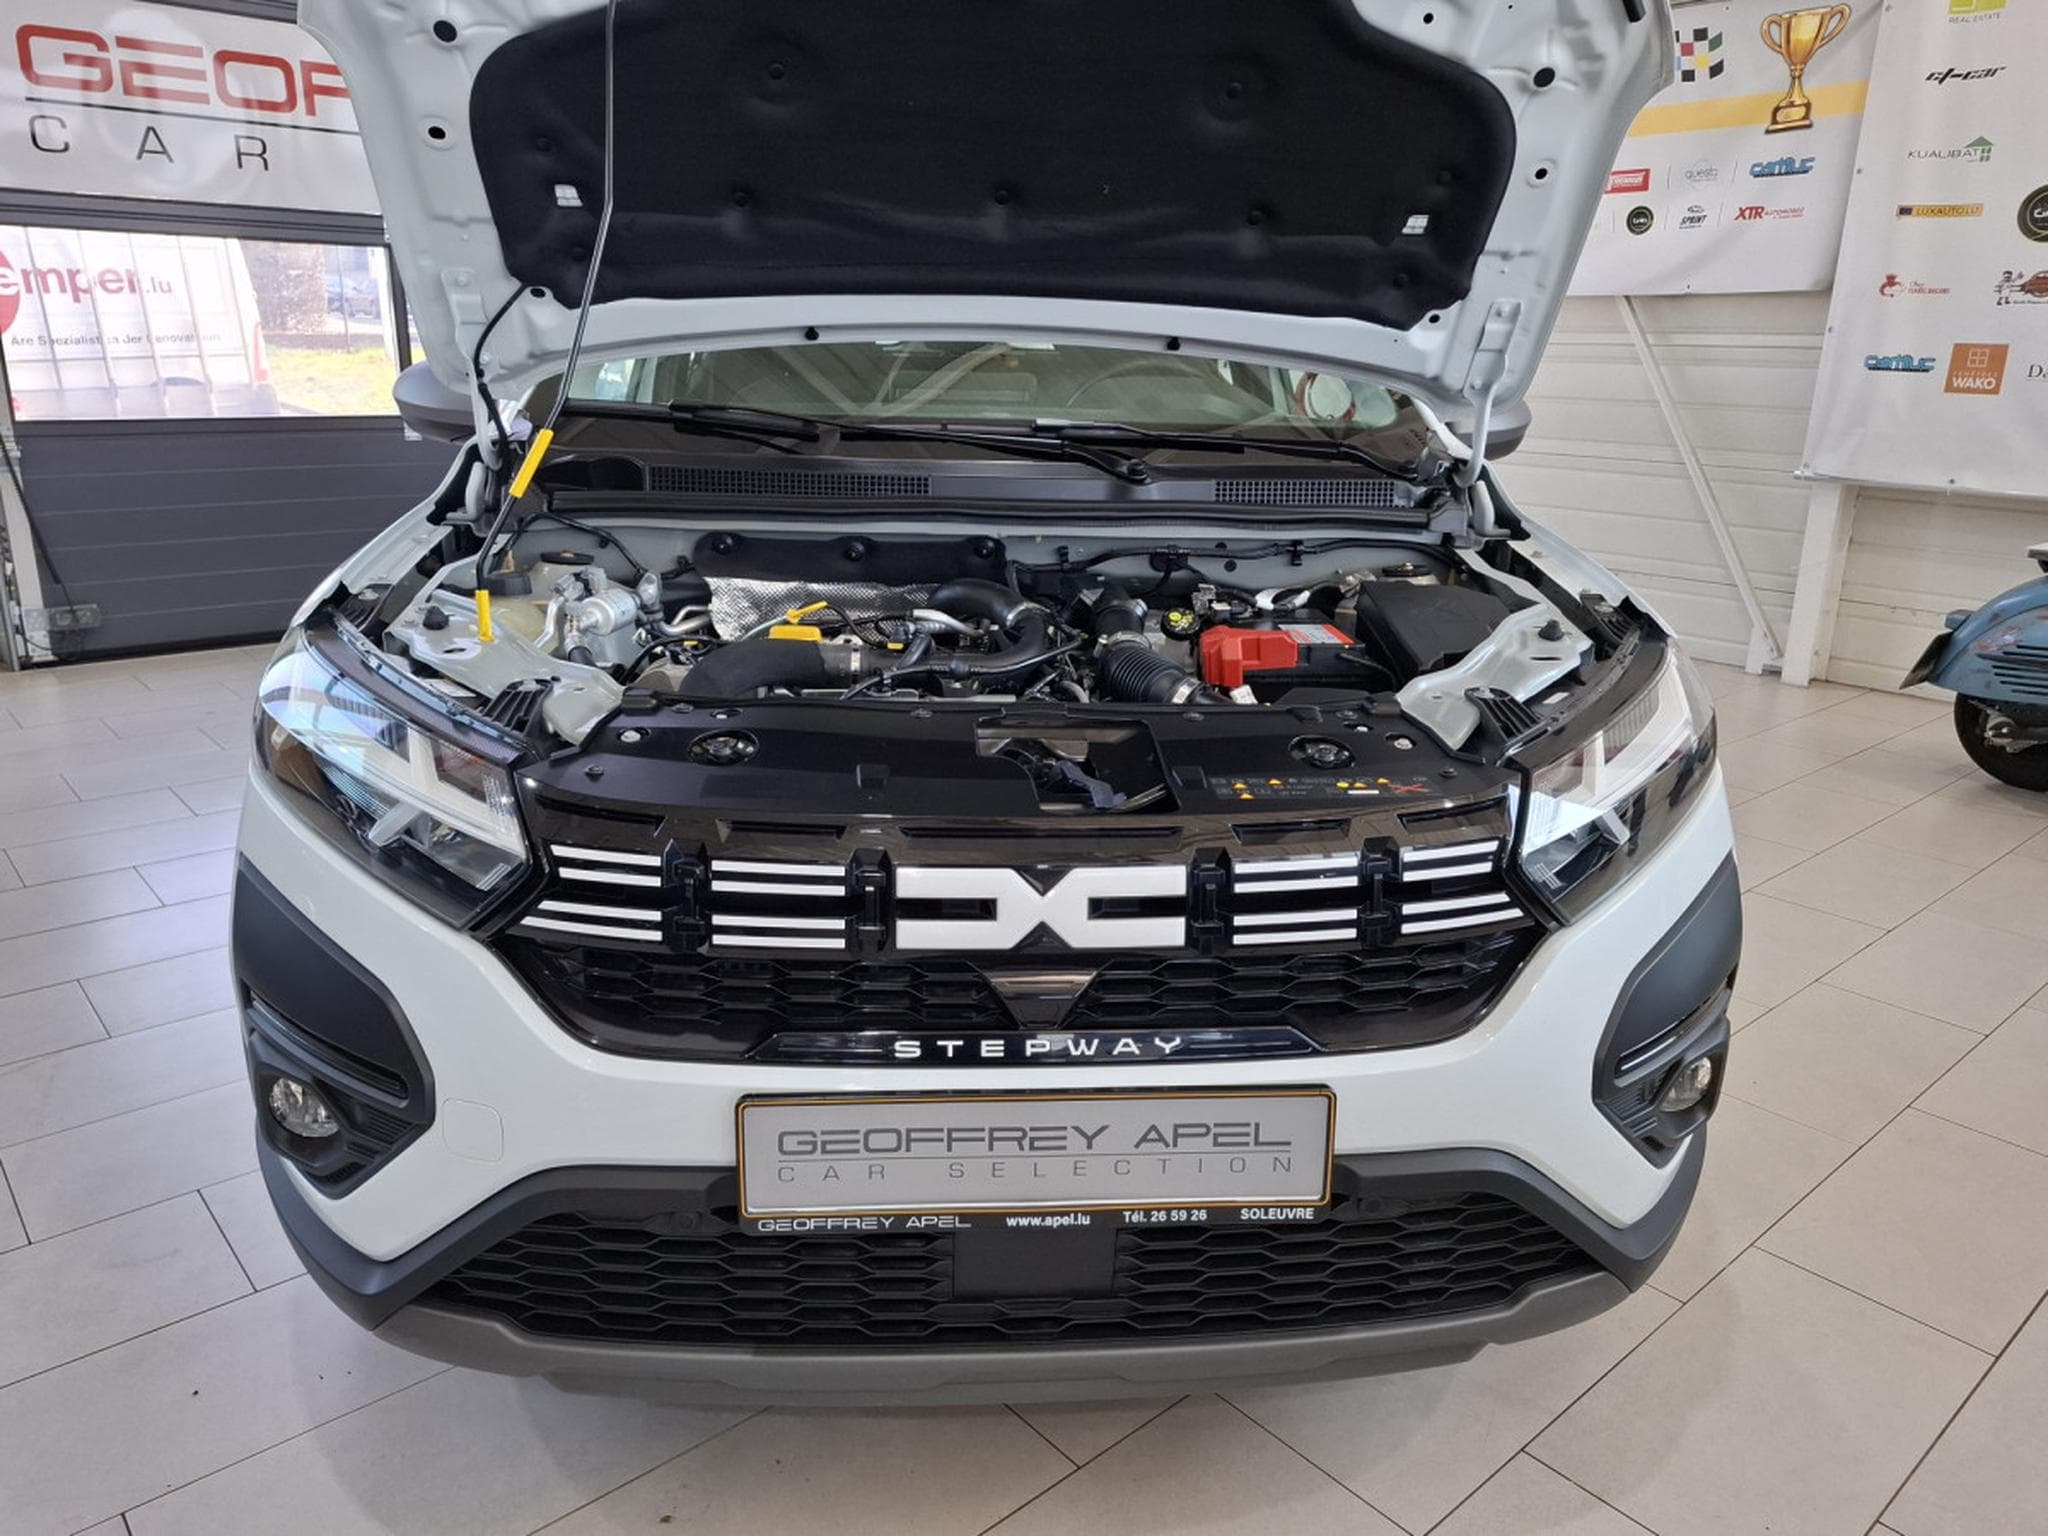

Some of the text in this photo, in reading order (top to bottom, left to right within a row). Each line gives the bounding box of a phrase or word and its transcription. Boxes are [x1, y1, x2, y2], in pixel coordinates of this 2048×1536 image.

[28, 114, 270, 171] CAR
[1734, 206, 1765, 221] XTR
[1952, 377, 1996, 390] WAKO
[894, 1036, 1184, 1058] STEPWAY
[777, 1121, 1292, 1155] GEOFFREY APEL
[777, 1156, 1292, 1183] CAR SELECTION
[757, 1207, 1315, 1232] GEOFFREY APEL www.apel.lu Tél. 26 59 26 SOLEUVRE
